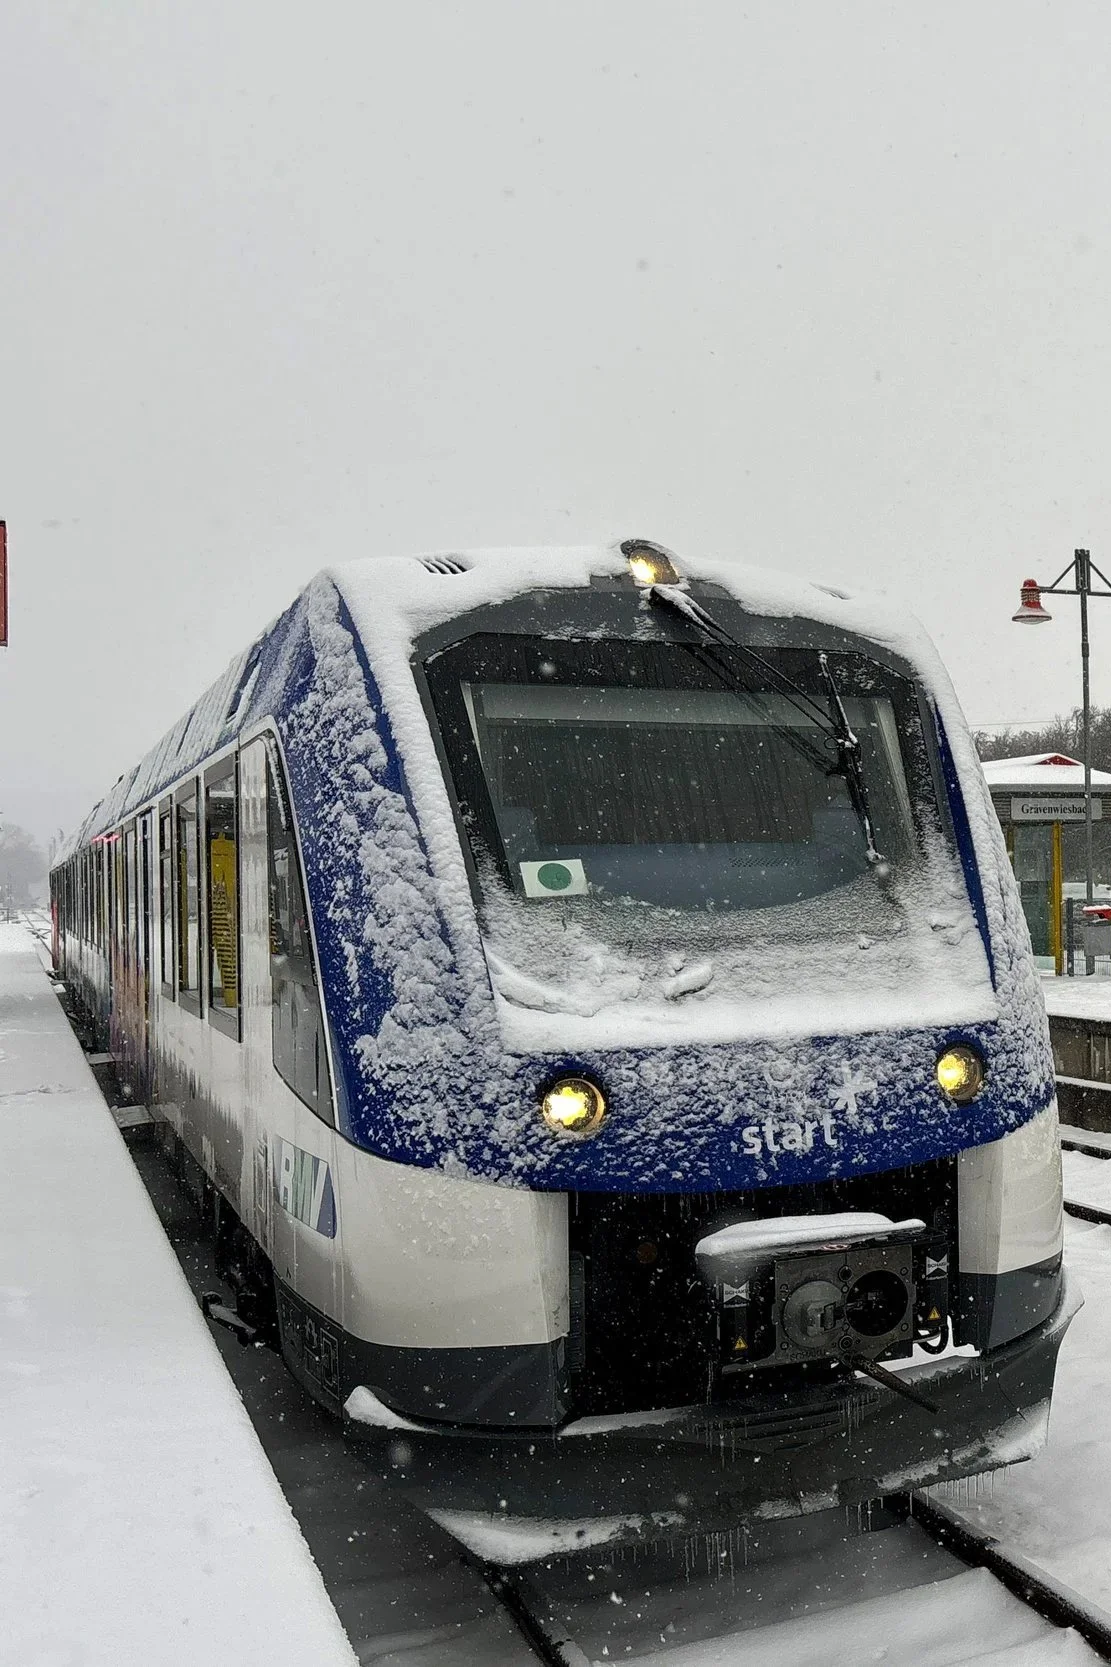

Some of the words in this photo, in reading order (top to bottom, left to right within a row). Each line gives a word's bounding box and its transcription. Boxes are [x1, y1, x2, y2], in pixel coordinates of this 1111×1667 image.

[1021, 803, 1088, 814] Grävenwiesbac
[741, 1113, 838, 1155] start
[279, 1140, 329, 1231] RMV
